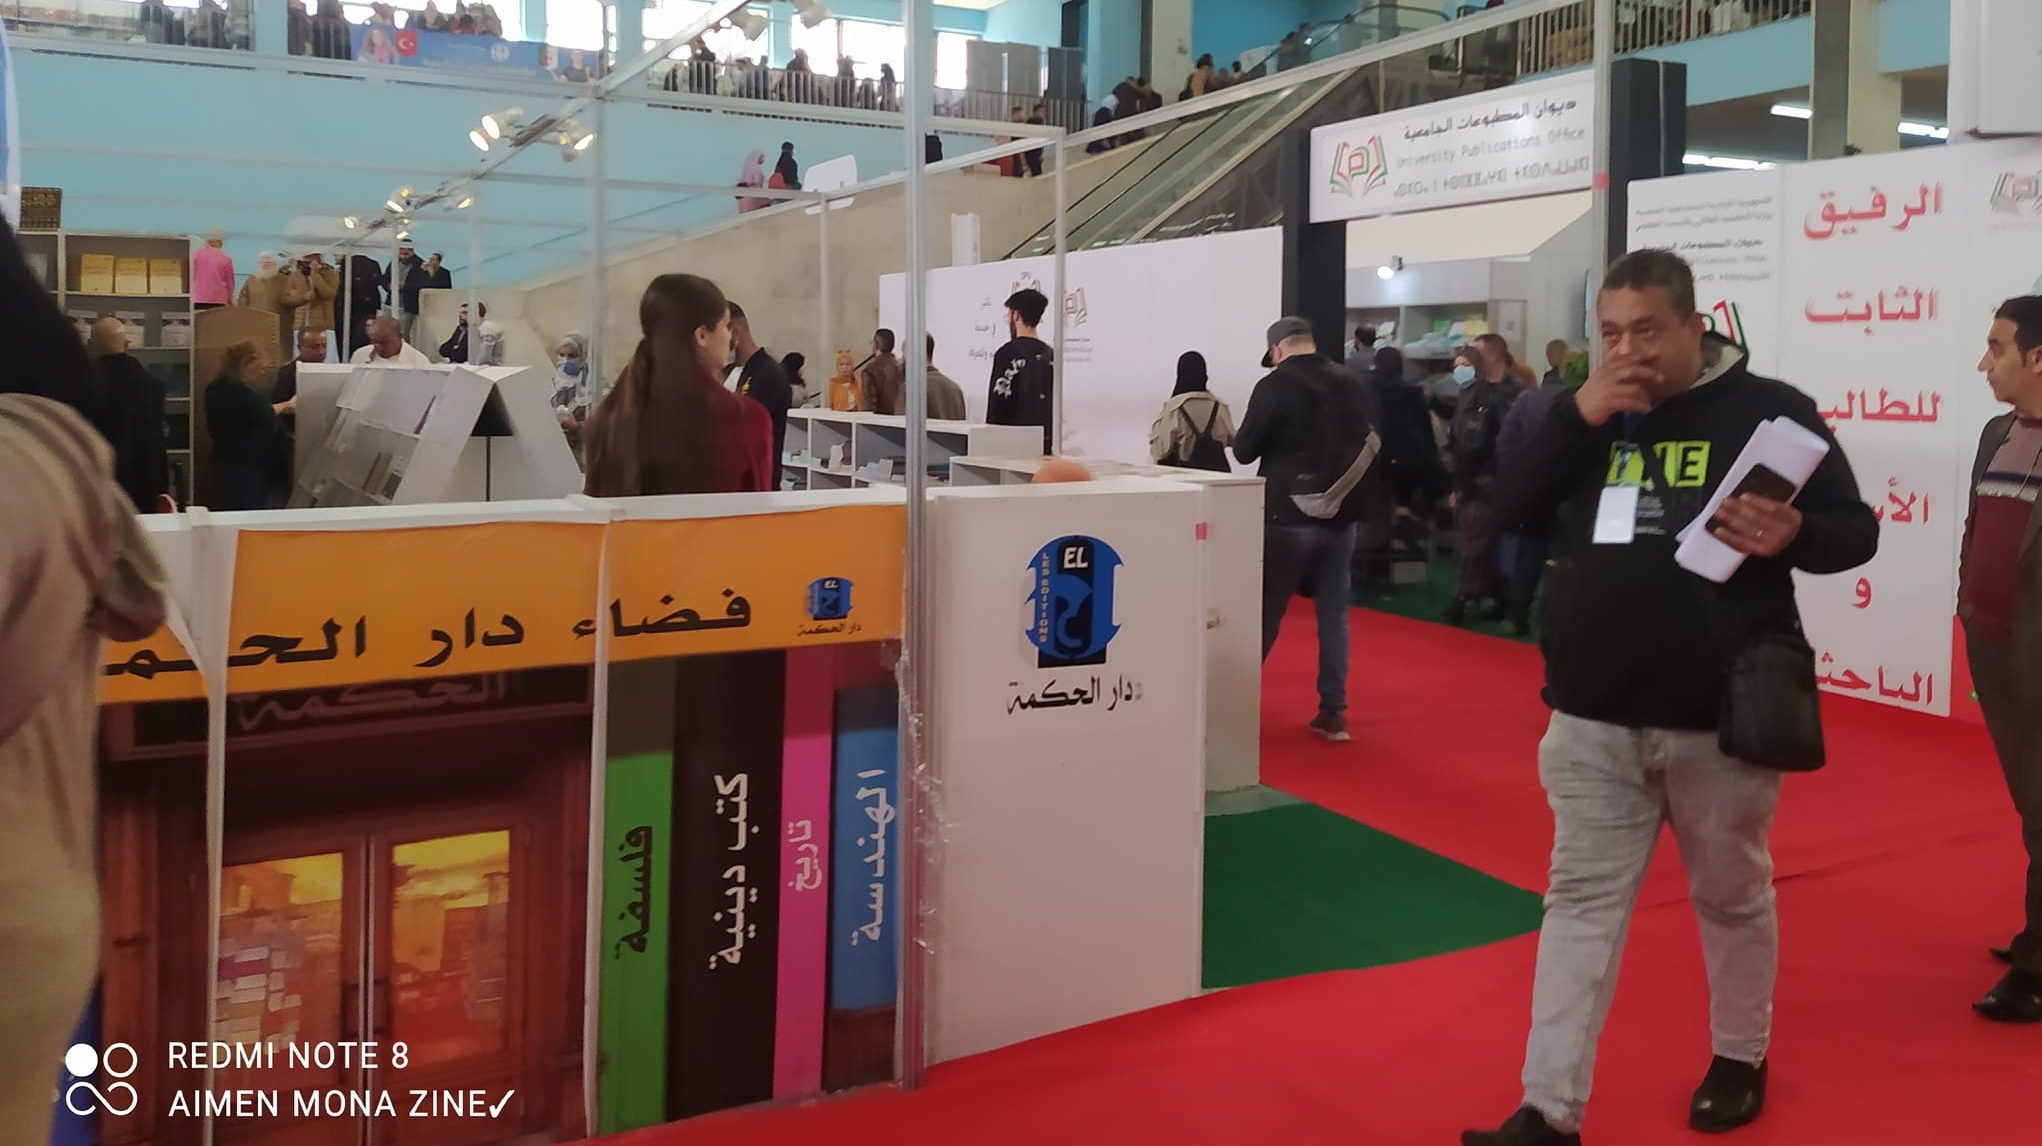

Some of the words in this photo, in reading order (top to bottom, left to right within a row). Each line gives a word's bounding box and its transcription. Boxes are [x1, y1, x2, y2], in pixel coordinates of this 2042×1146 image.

[1404, 117, 1452, 143] الجامعية
[1457, 103, 1529, 131] المطبوعات
[1535, 98, 1577, 119] ديوان
[1397, 148, 1455, 169] University
[1461, 135, 1541, 157] Publications
[1547, 127, 1585, 144] Office
[1803, 181, 1943, 241] الرفيق
[1804, 285, 1938, 336] الثابت
[1063, 547, 1089, 569] EL
[571, 588, 751, 640] فضاء
[1852, 577, 1872, 609] و
[415, 608, 525, 668] دار
[1007, 674, 1101, 715] الحكمة
[714, 773, 760, 850] كتب
[787, 819, 823, 891] تاريخ
[851, 769, 896, 946] الهندسة
[614, 825, 653, 960] فلسفة
[708, 864, 758, 970] دينية
